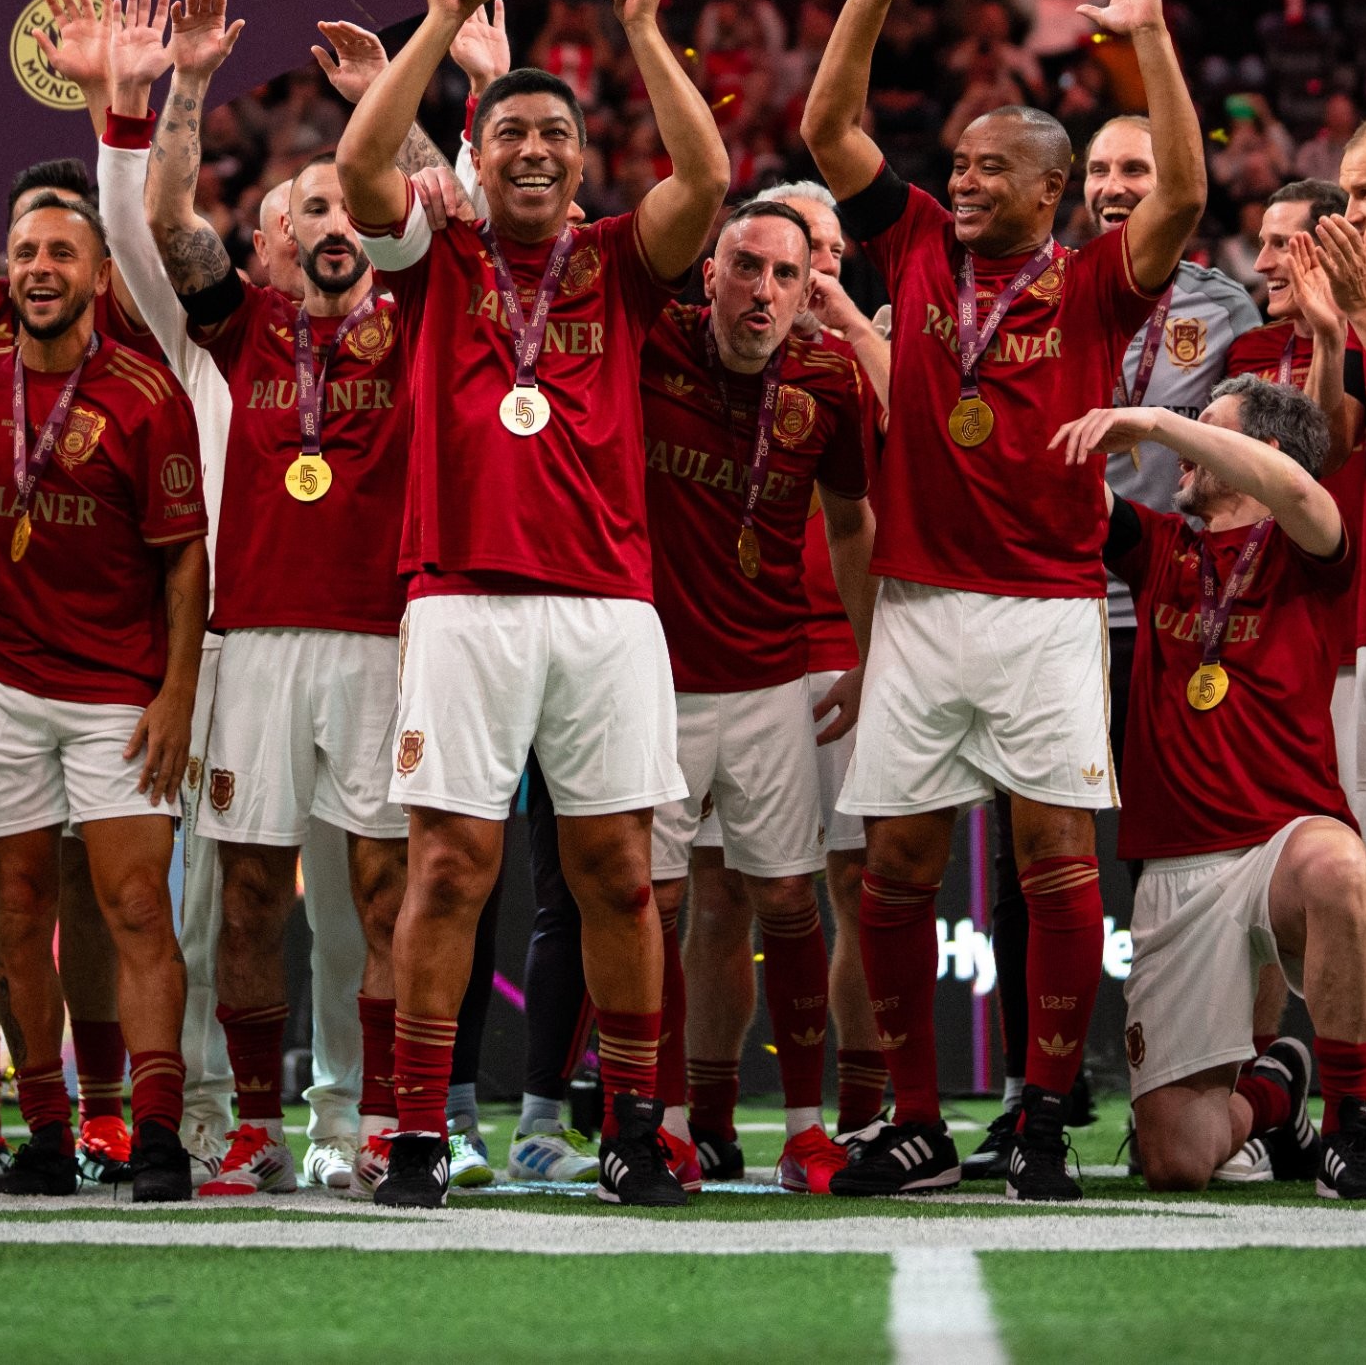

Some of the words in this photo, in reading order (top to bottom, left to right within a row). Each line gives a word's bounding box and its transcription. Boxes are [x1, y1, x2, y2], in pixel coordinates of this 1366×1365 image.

[549, 254, 565, 278] 2025
[1011, 272, 1031, 291] 2025
[503, 290, 518, 314] 2025
[962, 302, 972, 326] 2025
[466, 284, 604, 355] PAUNER
[523, 342, 537, 367] 2025
[59, 384, 74, 409] 2025
[247, 379, 394, 413] PAUNER
[765, 384, 776, 409] 2025
[306, 412, 315, 436] 2025
[515, 396, 535, 429] 5
[299, 464, 318, 495] 5
[747, 484, 759, 510] 2025
[163, 500, 202, 520] Allianz
[1242, 541, 1258, 562] 2025
[1210, 622, 1223, 645] 2025
[1198, 674, 1216, 704] 5
[1039, 995, 1078, 1010] 125
